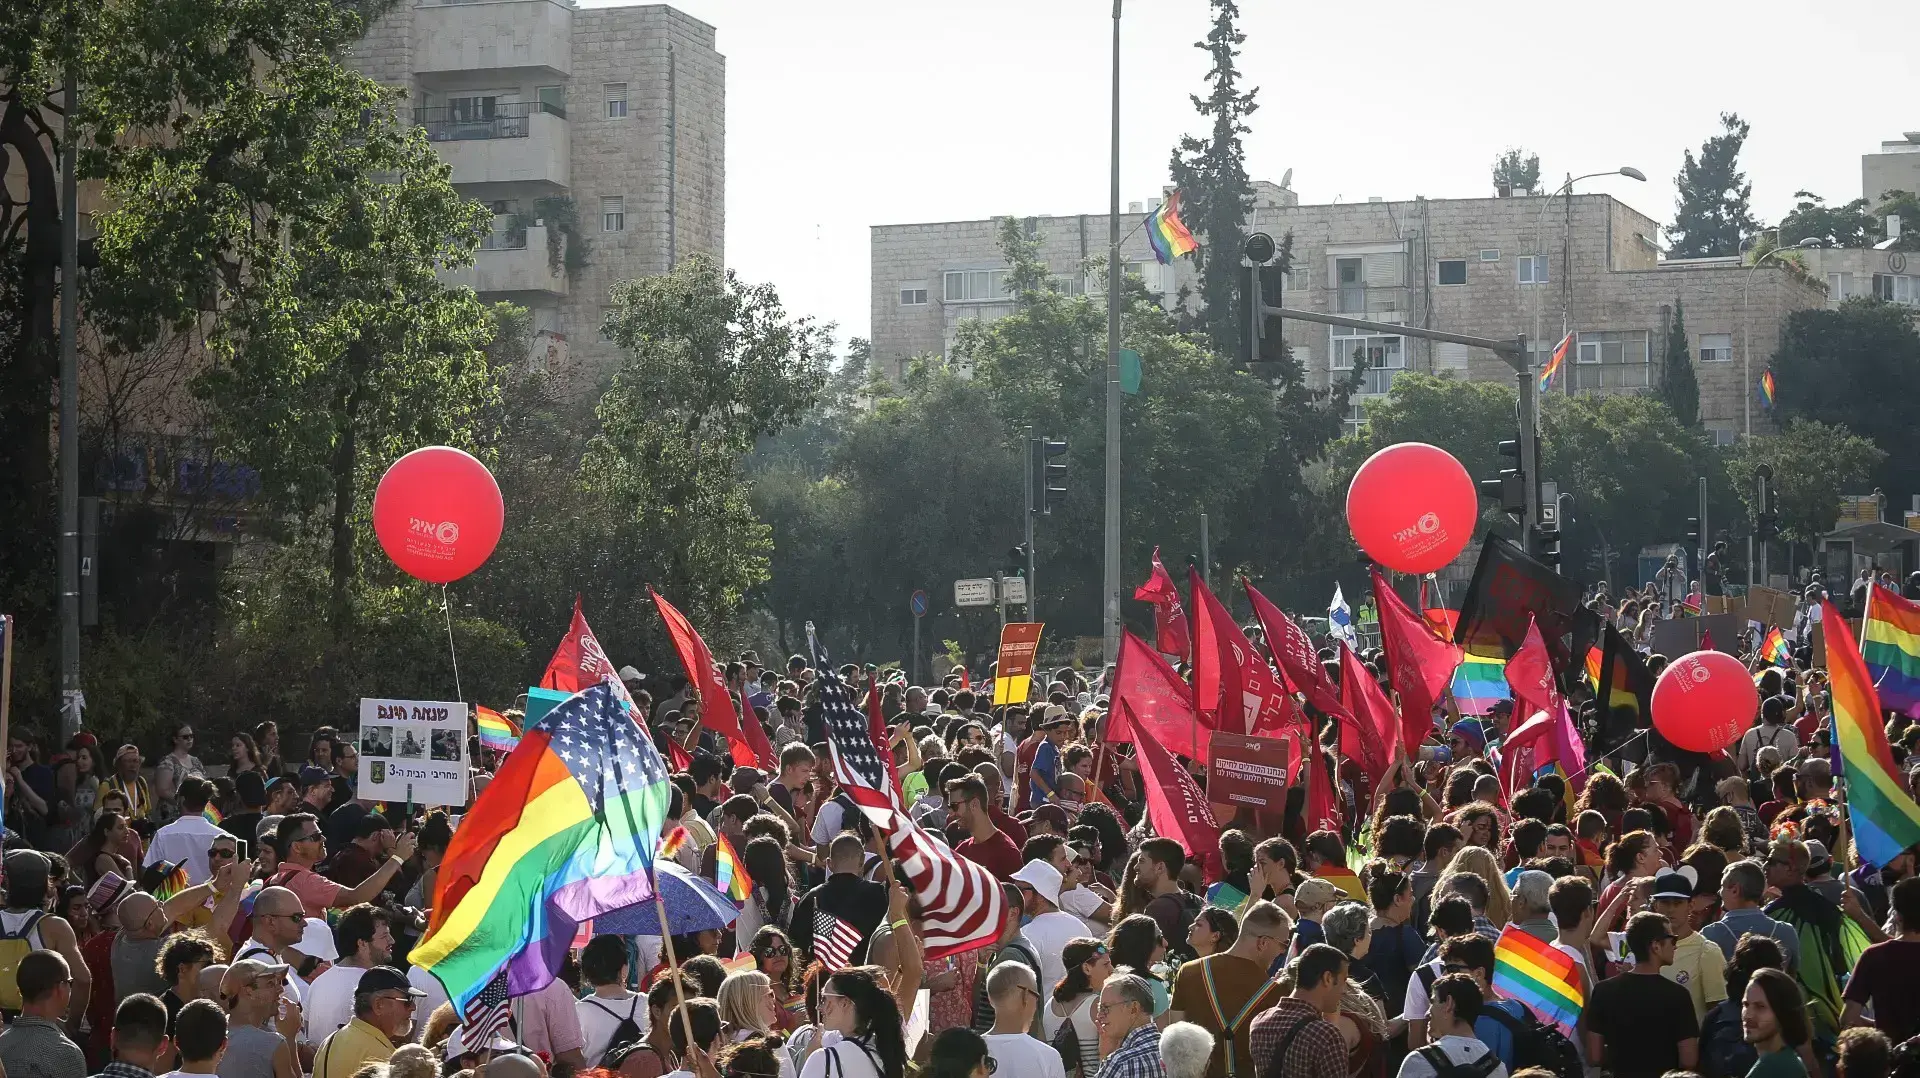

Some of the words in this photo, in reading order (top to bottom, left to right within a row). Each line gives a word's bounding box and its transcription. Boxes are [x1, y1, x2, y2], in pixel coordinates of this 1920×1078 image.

[409, 517, 436, 535] איגי
[1392, 524, 1419, 542] איגי
[579, 651, 598, 672] איגי
[377, 704, 408, 720] חינם
[411, 707, 449, 721] שנאת
[389, 764, 404, 777] ה-3
[406, 769, 426, 779] הבית
[431, 771, 458, 780] מחריבי
[1267, 768, 1286, 778] אנחנו
[1263, 776, 1284, 786] שתמיד
